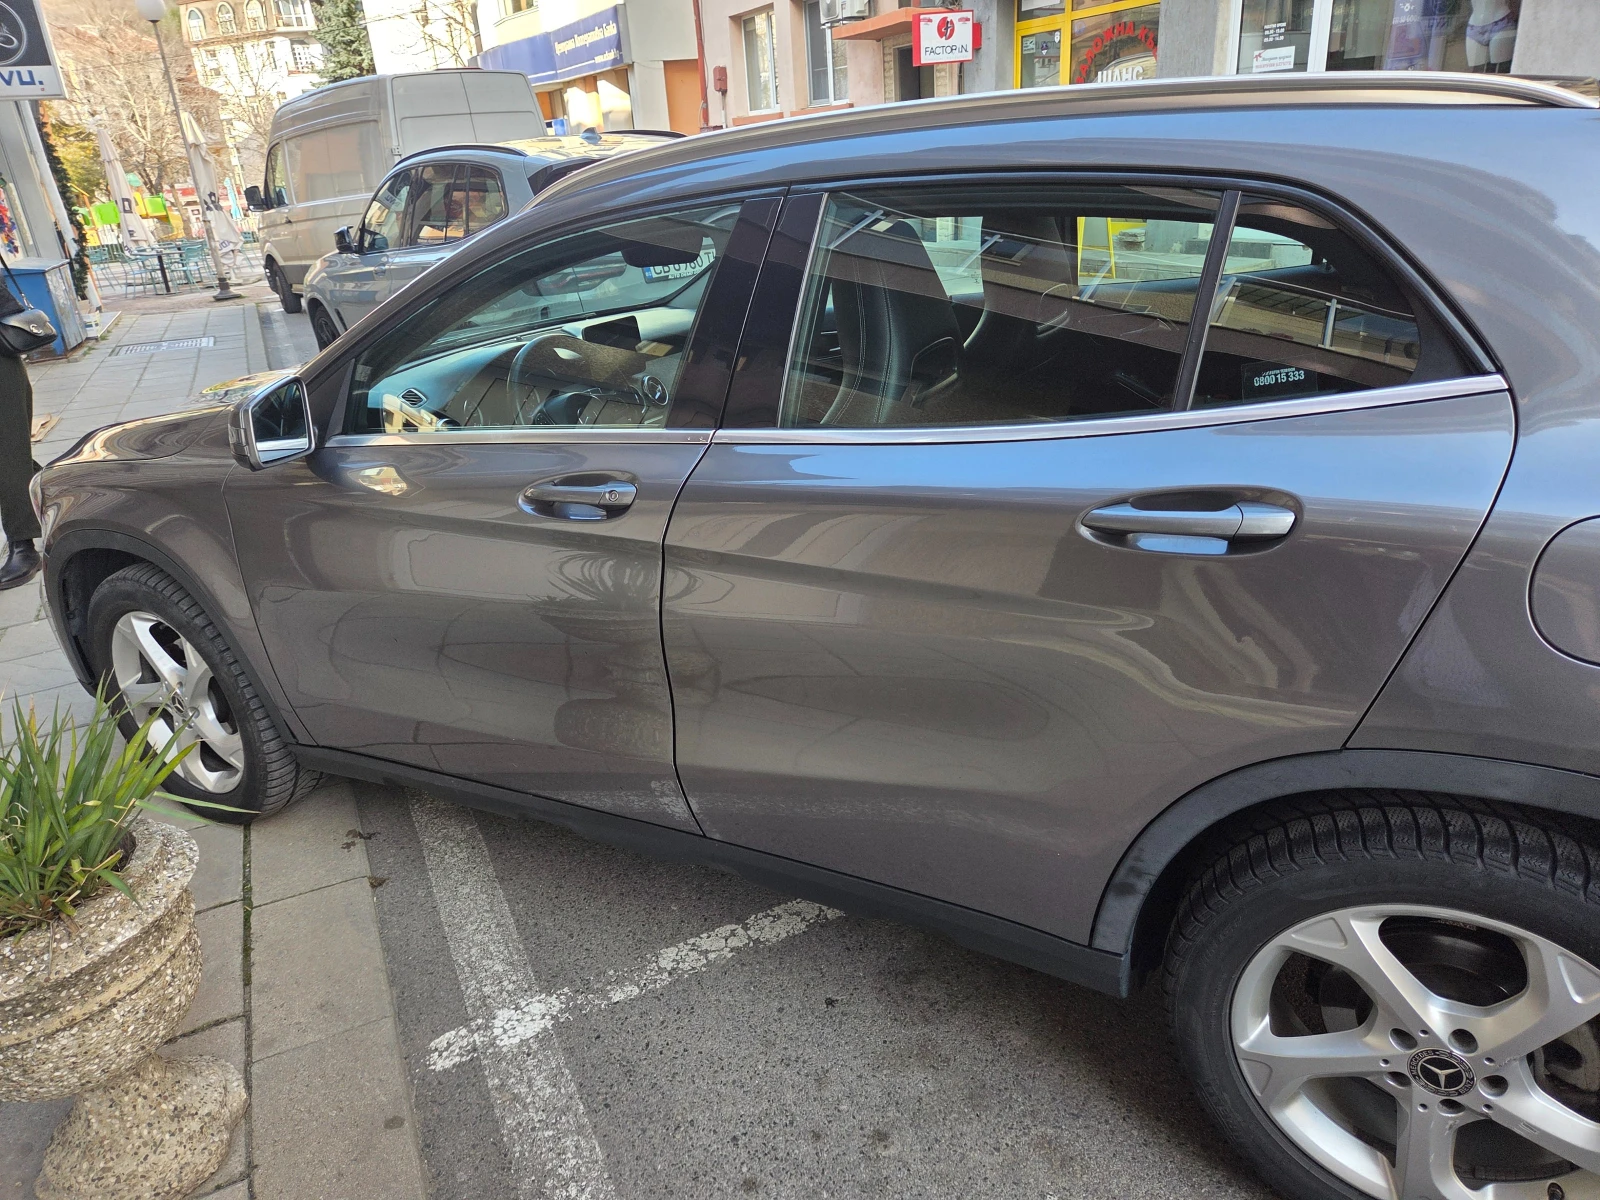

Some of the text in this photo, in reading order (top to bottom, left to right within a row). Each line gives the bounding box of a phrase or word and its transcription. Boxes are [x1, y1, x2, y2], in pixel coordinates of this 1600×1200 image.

[1097, 65, 1144, 83] ШАНС
[1254, 375, 1275, 386] 0800
[1276, 373, 1287, 383] 15
[1288, 370, 1304, 381] 333
[1410, 1050, 1434, 1075] MERCEDES
[1459, 1079, 1474, 1094] BENZ
